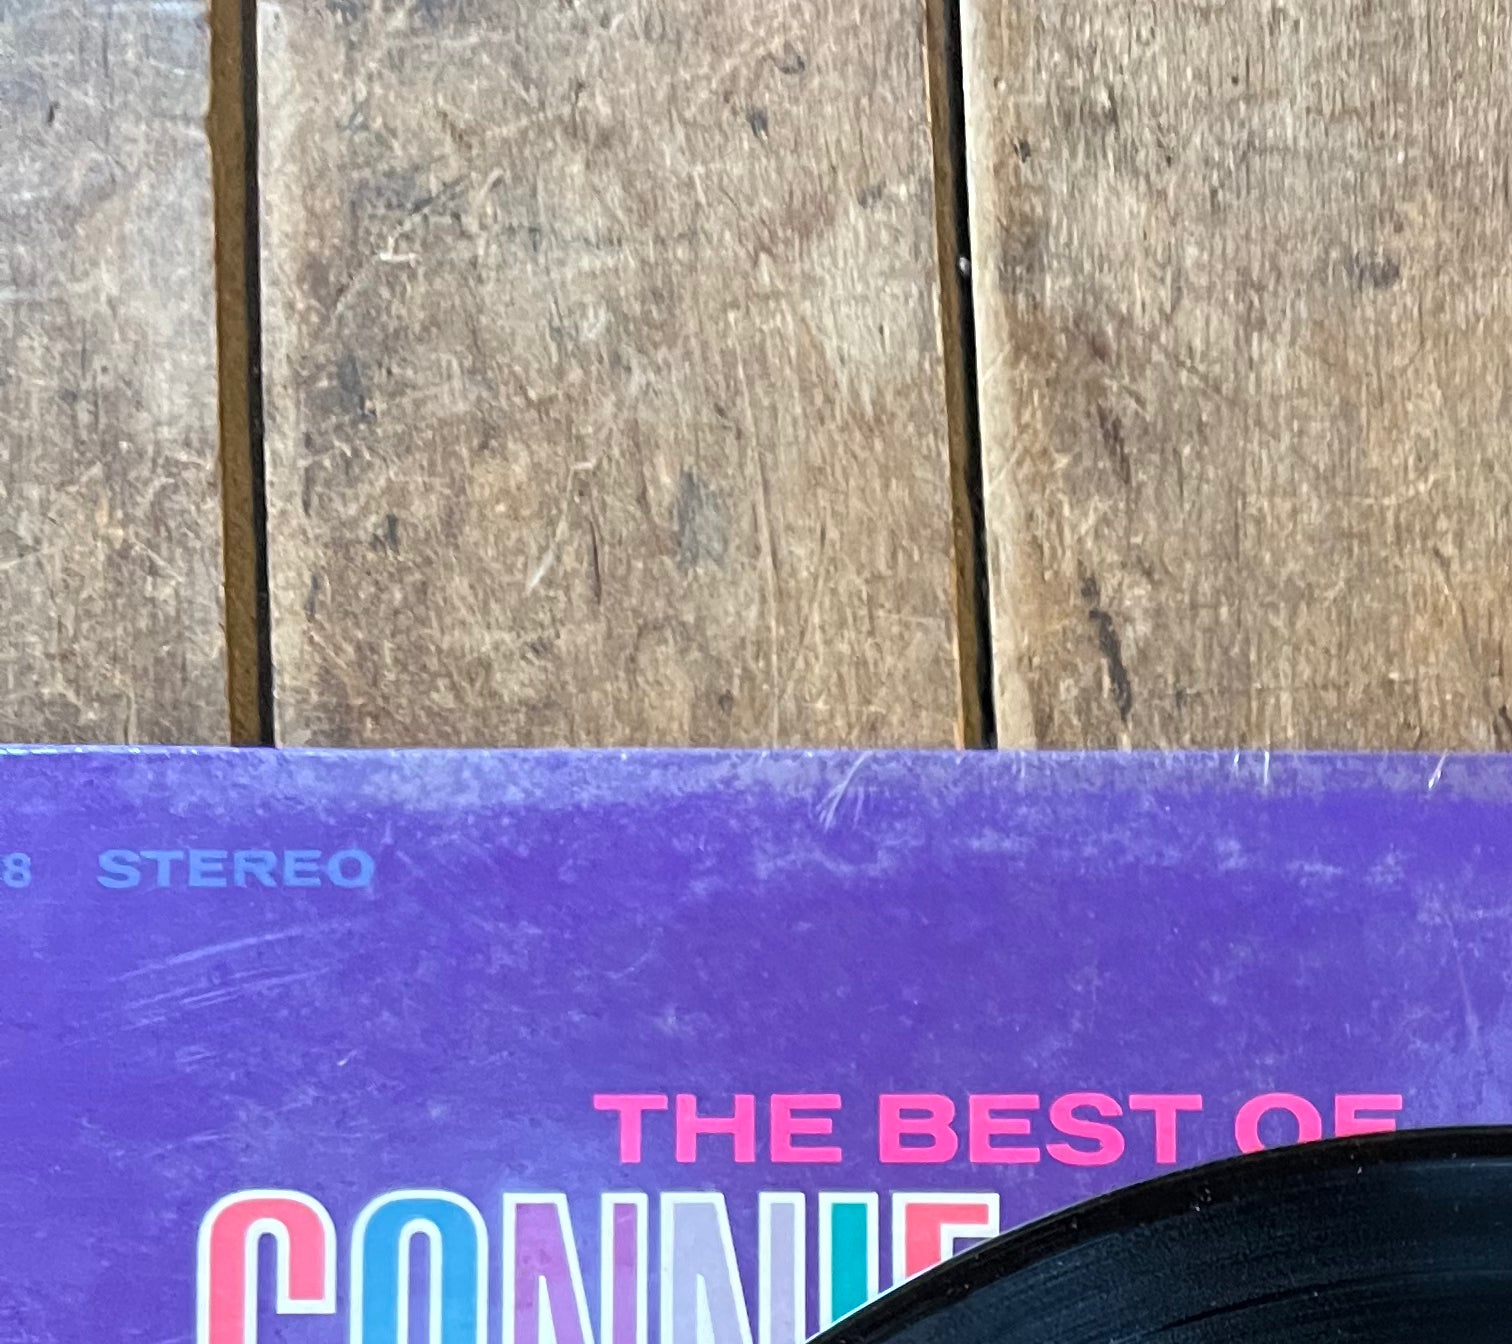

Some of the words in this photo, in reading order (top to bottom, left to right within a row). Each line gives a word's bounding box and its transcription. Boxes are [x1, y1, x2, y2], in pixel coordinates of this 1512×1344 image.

[97, 849, 375, 888] STEREO
[594, 1093, 843, 1164] THE
[878, 1093, 1203, 1166] BEST
